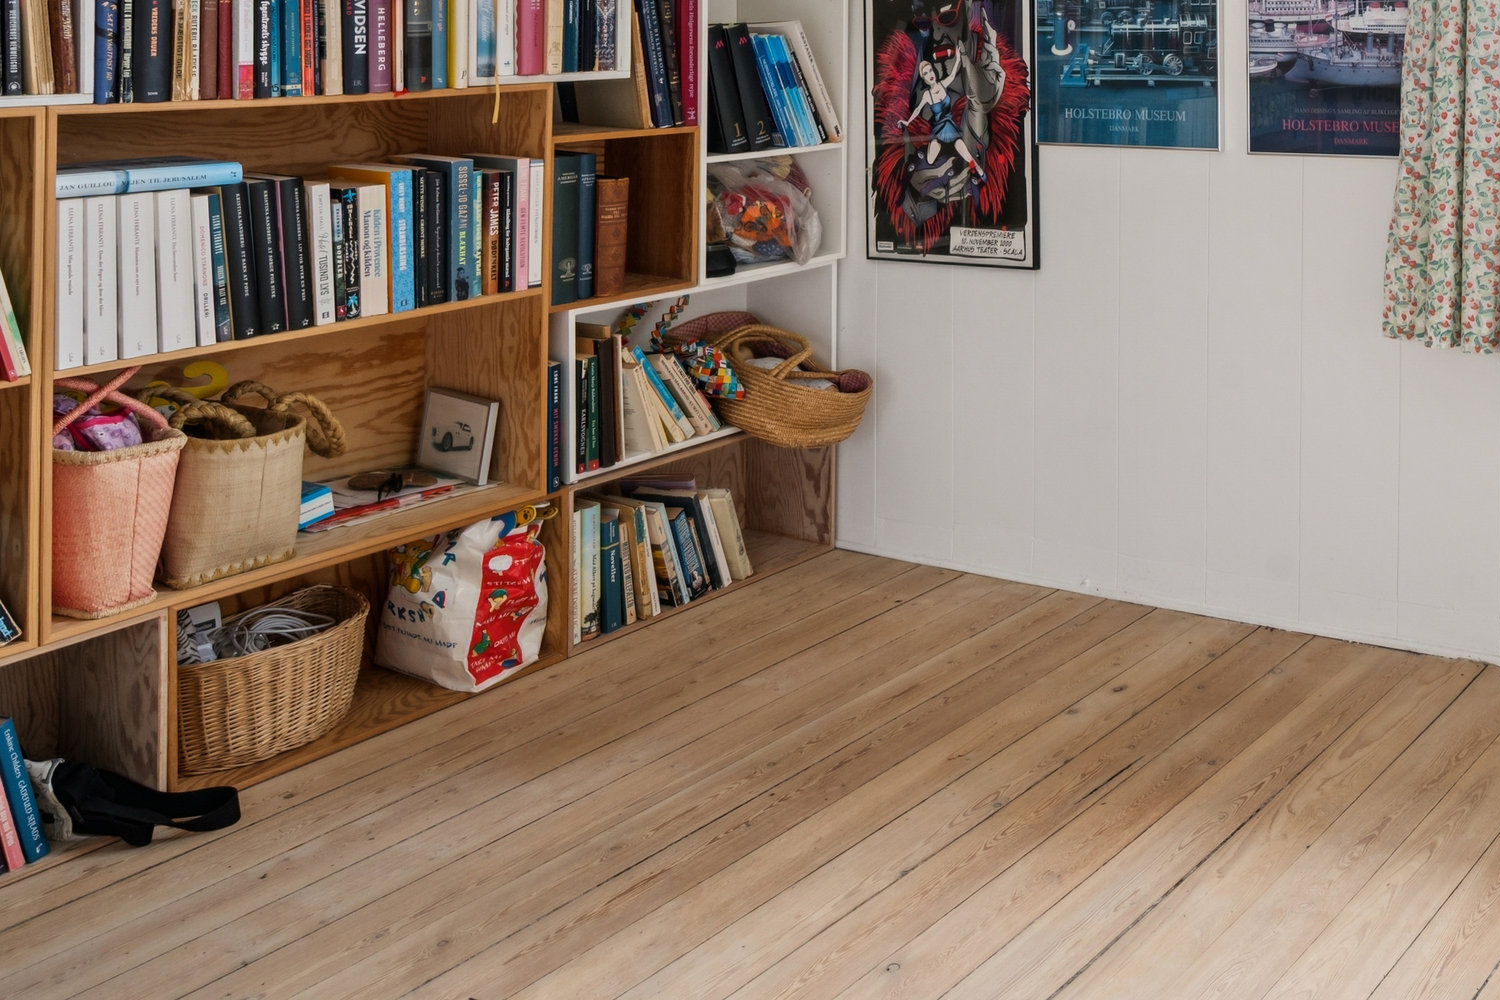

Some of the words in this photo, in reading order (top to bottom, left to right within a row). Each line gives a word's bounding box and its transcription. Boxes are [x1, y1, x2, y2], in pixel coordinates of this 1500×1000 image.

[260, 1, 270, 39] figentræets
[107, 28, 113, 37] EN
[260, 40, 270, 65] skygge
[654, 28, 665, 74] BILLEDBOG
[1064, 108, 1131, 120] HOLSTEBRO
[1135, 110, 1186, 121] MUSEUM
[1282, 119, 1359, 132] HOLSTEBRO
[1363, 121, 1400, 133] MUSE
[734, 122, 742, 137] 1
[756, 120, 766, 135] 2
[163, 174, 207, 183] JERUSALEM
[458, 166, 468, 204] SISSEL-JO
[491, 182, 499, 206] PETER
[211, 214, 222, 230] ELENA
[373, 209, 382, 236] Kilden
[458, 205, 467, 229] GAZAN
[490, 209, 499, 236] JAMES
[213, 231, 223, 254] FERRANTE
[362, 240, 370, 250] og
[960, 230, 1015, 238] VERDENSPREMIERE
[319, 255, 328, 282] TUSIND
[320, 283, 329, 295] LYS
[4, 729, 14, 752] Erskine
[10, 752, 21, 778] Childers
[18, 780, 31, 814] GÅDEFULD
[27, 815, 40, 840] SEJLADS
